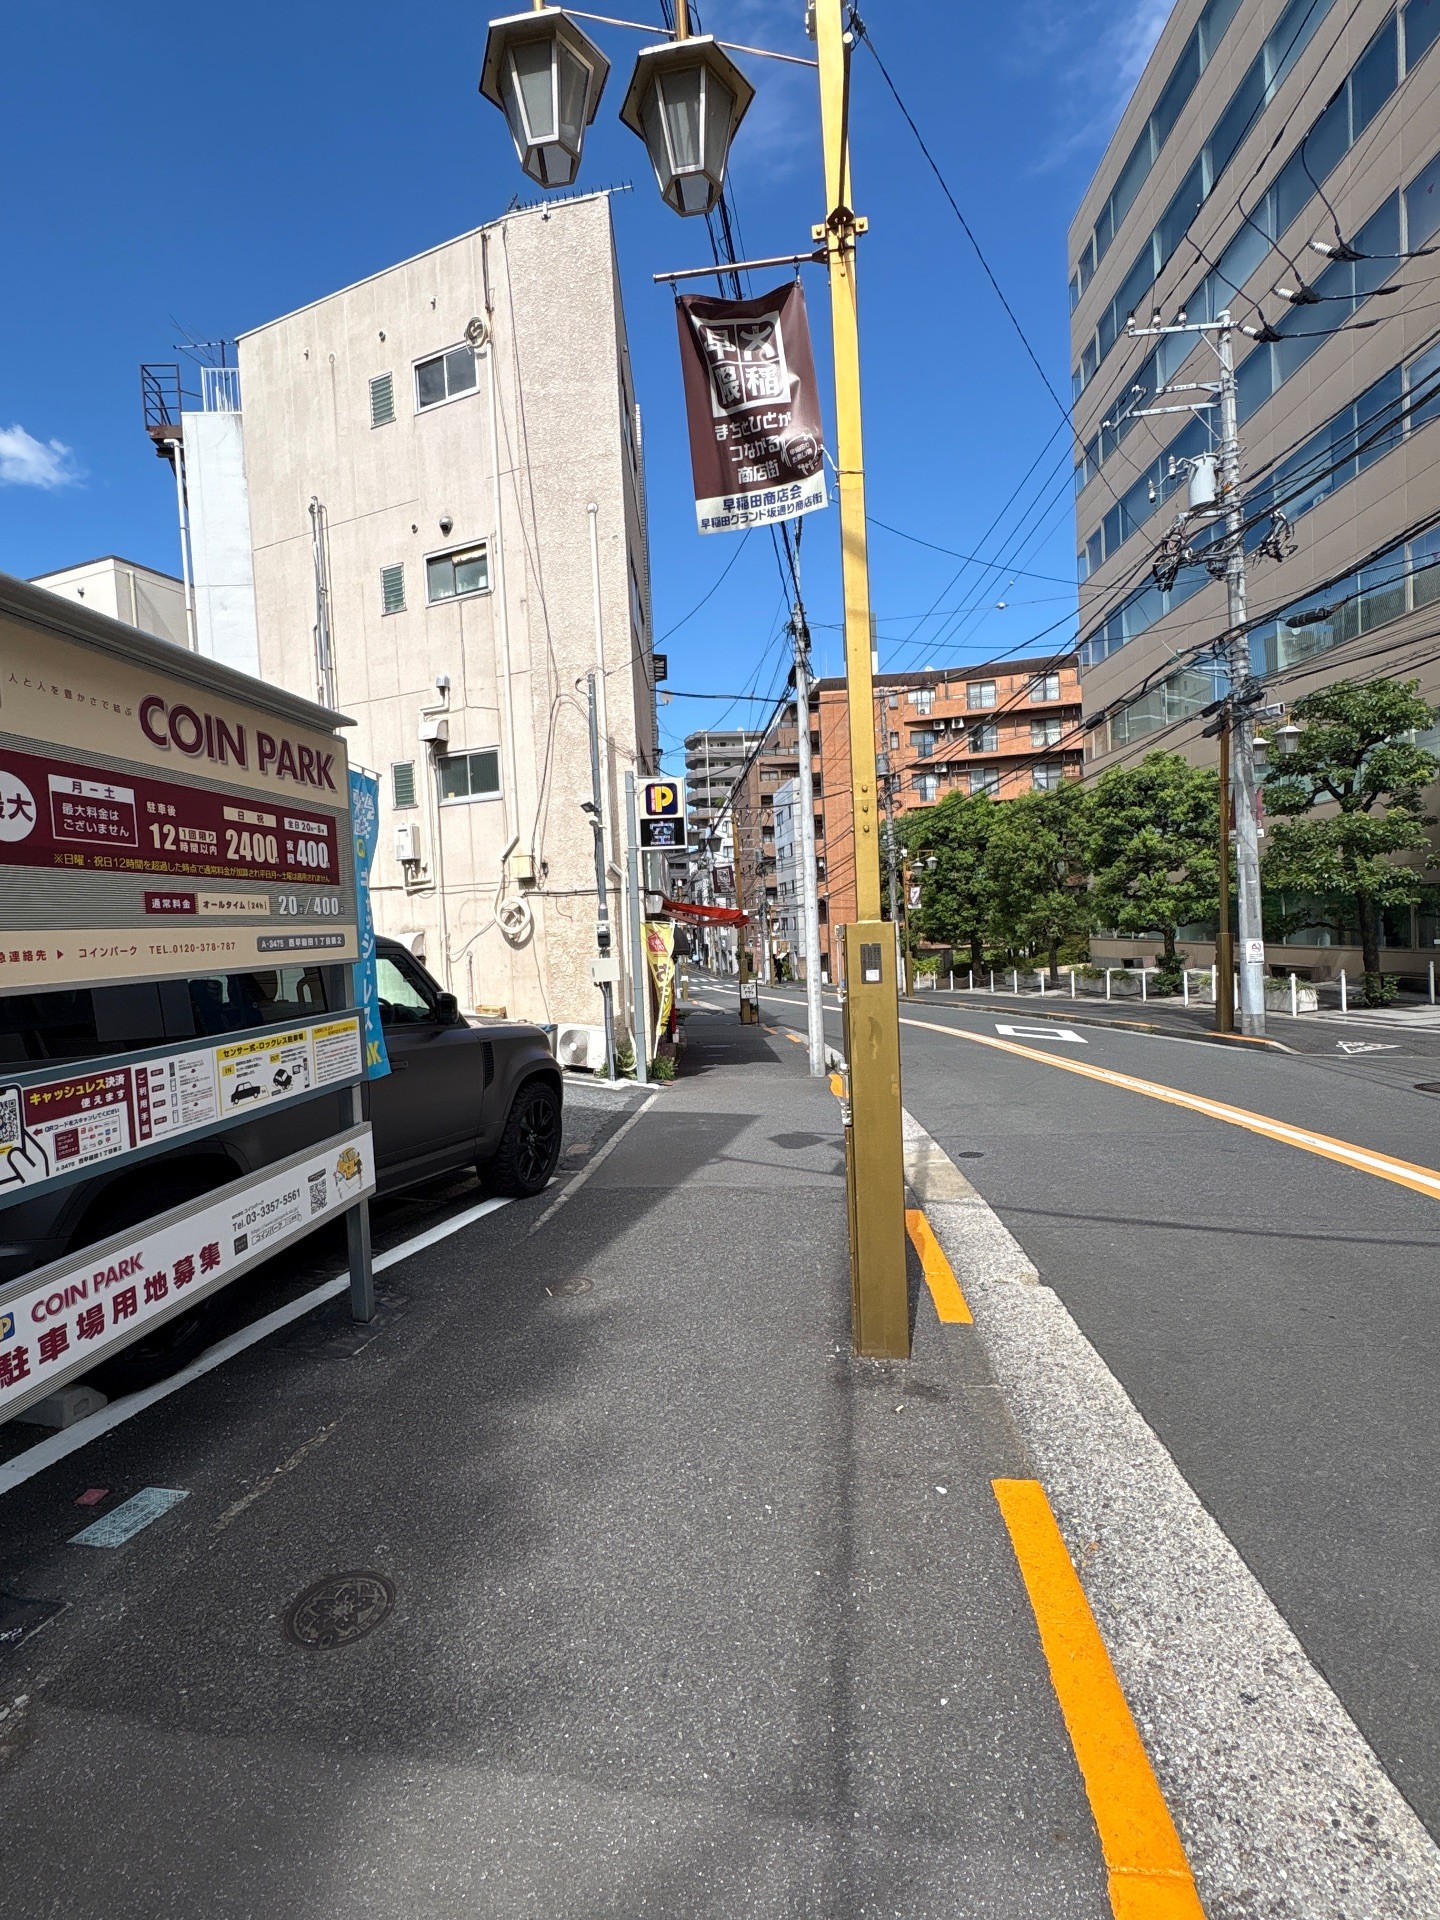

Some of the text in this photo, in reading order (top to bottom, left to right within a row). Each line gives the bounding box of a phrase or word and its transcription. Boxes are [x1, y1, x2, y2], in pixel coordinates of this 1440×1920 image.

[715, 411, 791, 441] まちとひとが
[729, 434, 780, 462] つながる
[737, 459, 780, 484] 商店街
[701, 491, 823, 529] 早稲田グランド坂通り商店街
[723, 484, 802, 513] 早稲田商店会
[8, 672, 132, 717] 人と人を豊かさで結ぶ
[139, 695, 337, 792] COIN PARK
[62, 802, 120, 821] 最大料金は
[146, 801, 177, 817] 駐車後
[654, 786, 673, 812] P
[63, 818, 130, 837] ございません
[149, 823, 177, 850] 12
[179, 841, 218, 856] 時間以内
[151, 899, 191, 910] 通常料金
[79, 942, 236, 958] コインパーク TEL.0120-378-787
[29, 1073, 126, 1106] キャッシュレス決済
[80, 1089, 126, 1109] 使えます
[232, 1188, 301, 1232] Tel.03-3357-5561
[31, 1252, 145, 1323] COIN PARK
[0, 1241, 222, 1390] 駐車場用地募集
